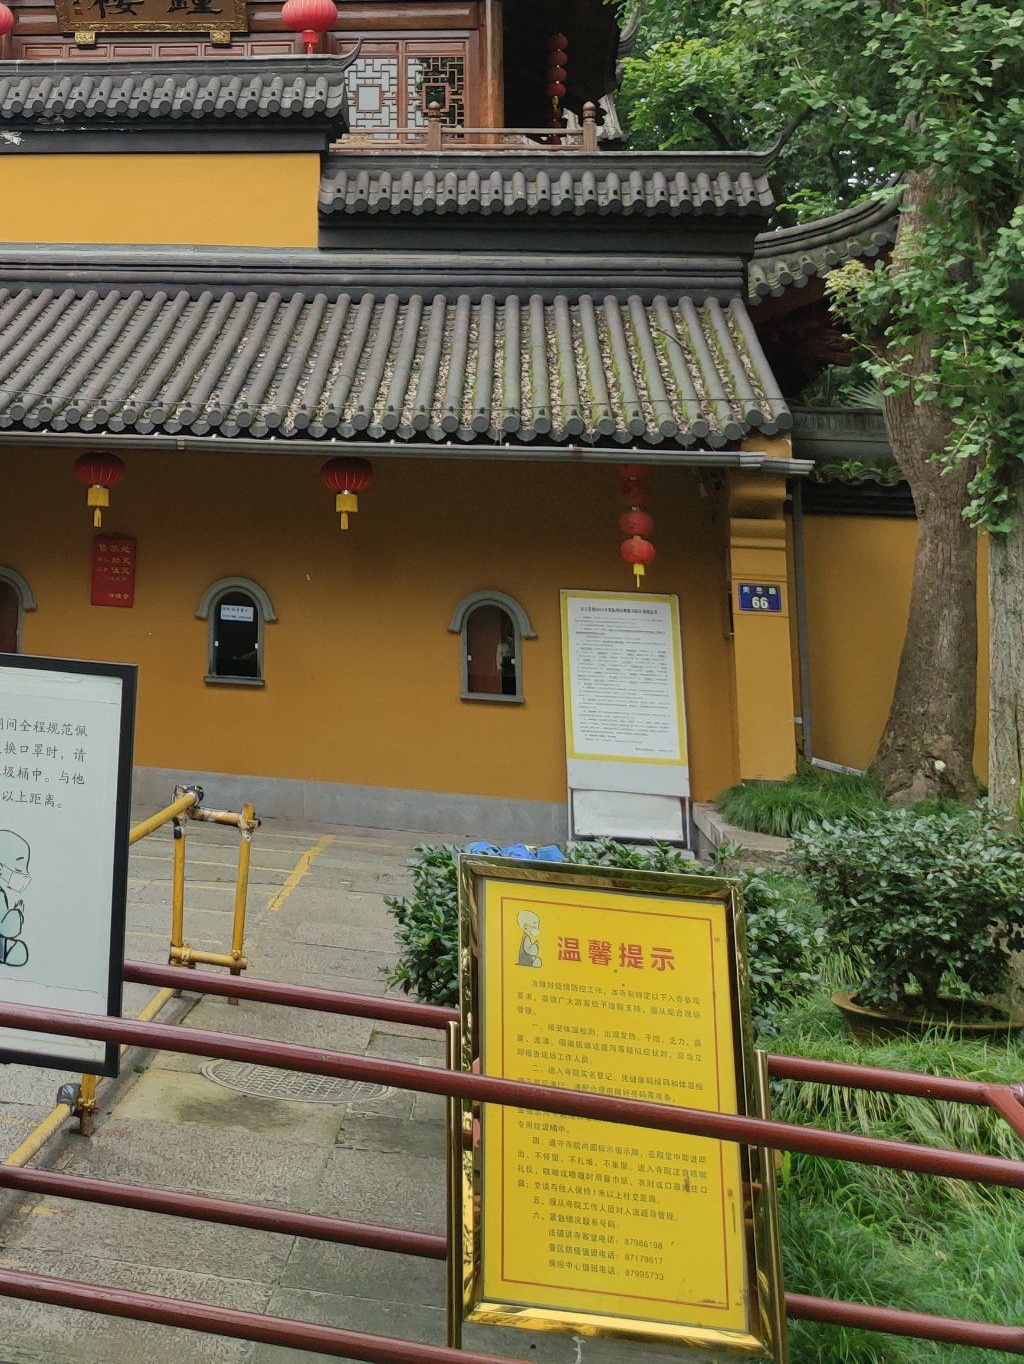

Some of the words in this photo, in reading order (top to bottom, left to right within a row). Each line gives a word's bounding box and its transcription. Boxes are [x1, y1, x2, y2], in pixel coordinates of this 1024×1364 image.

[751, 596, 770, 609] 66
[556, 935, 676, 974] 温馨提示
